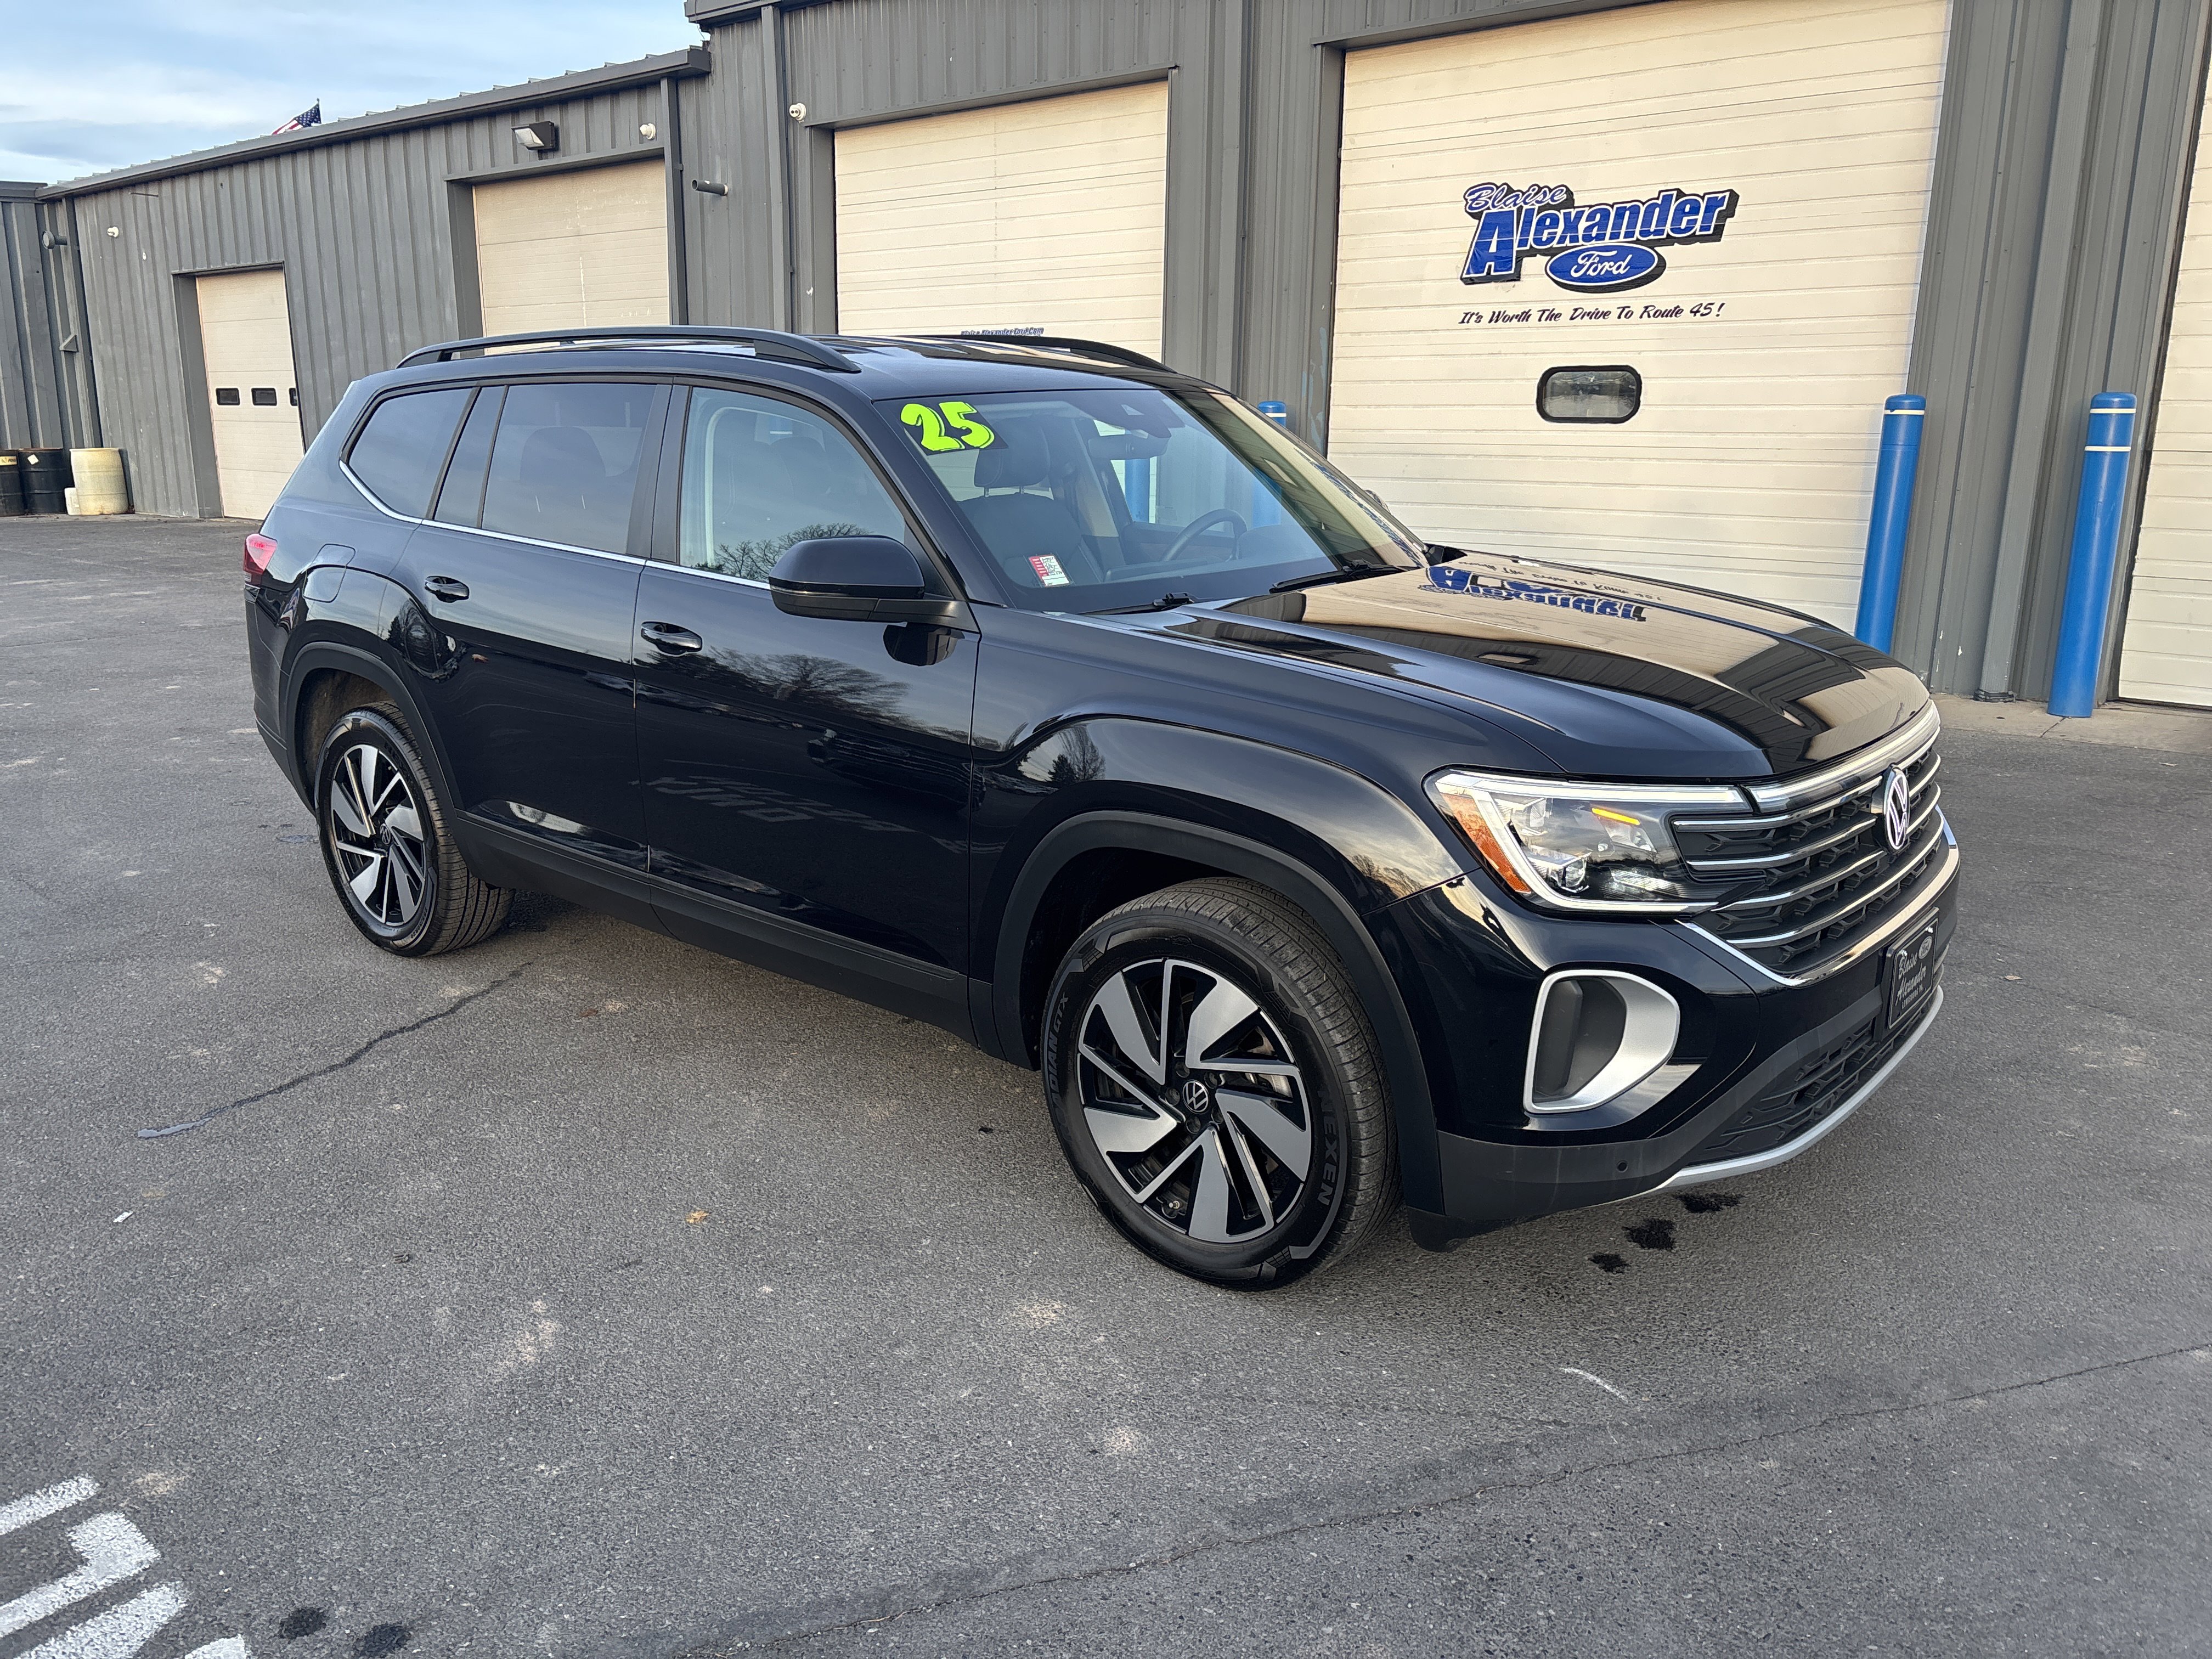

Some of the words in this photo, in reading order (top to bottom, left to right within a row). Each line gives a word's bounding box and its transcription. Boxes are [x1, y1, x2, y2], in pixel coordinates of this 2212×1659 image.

[1465, 184, 1568, 212] Blaise
[1462, 189, 1735, 284] Alexander
[1570, 251, 1630, 278] Ford
[1458, 312, 1483, 324] It's
[1488, 310, 1533, 324] Worth
[1537, 309, 1562, 323] The
[1569, 307, 1611, 321] Drive
[1616, 306, 1635, 319] To
[1640, 305, 1683, 319] Route
[1690, 302, 1725, 318] 45!
[900, 401, 995, 452] 25
[1317, 1091, 1337, 1206] NEXEN
